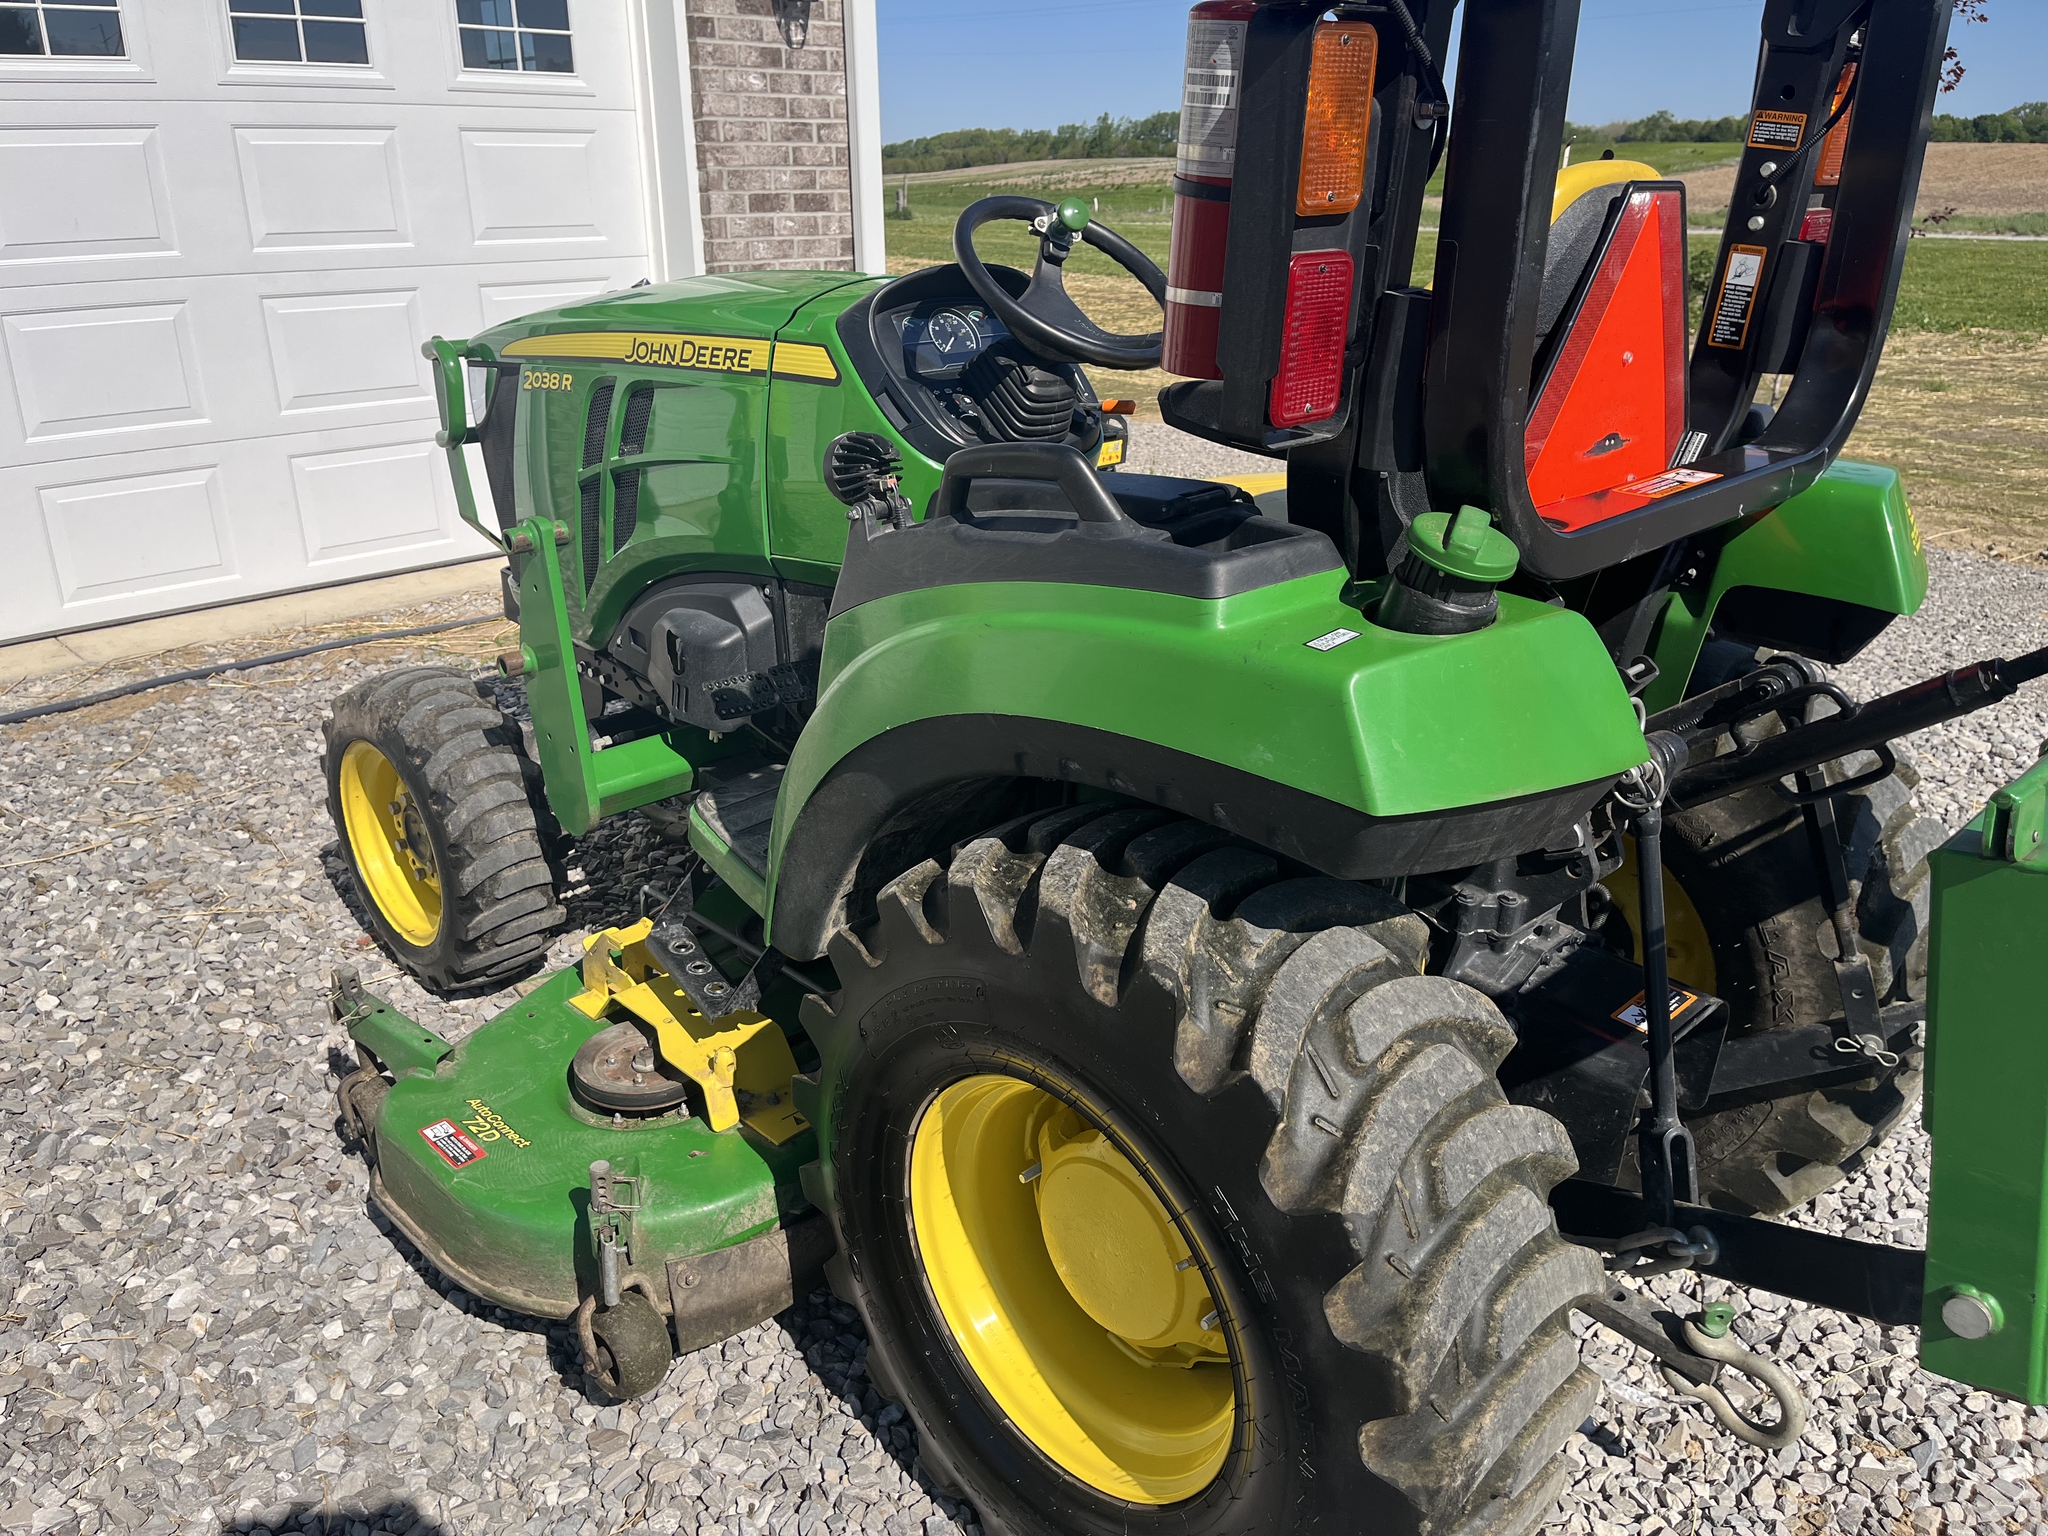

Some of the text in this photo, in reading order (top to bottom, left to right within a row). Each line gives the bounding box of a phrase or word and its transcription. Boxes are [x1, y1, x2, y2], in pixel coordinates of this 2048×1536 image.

[1764, 111, 1804, 122] WARNING
[624, 337, 752, 371] JOHN DEERE
[523, 370, 560, 390] 2038
[461, 1114, 501, 1142] 72D
[464, 1098, 532, 1149] AutoConnect
[462, 1137, 479, 1152] DANGER
